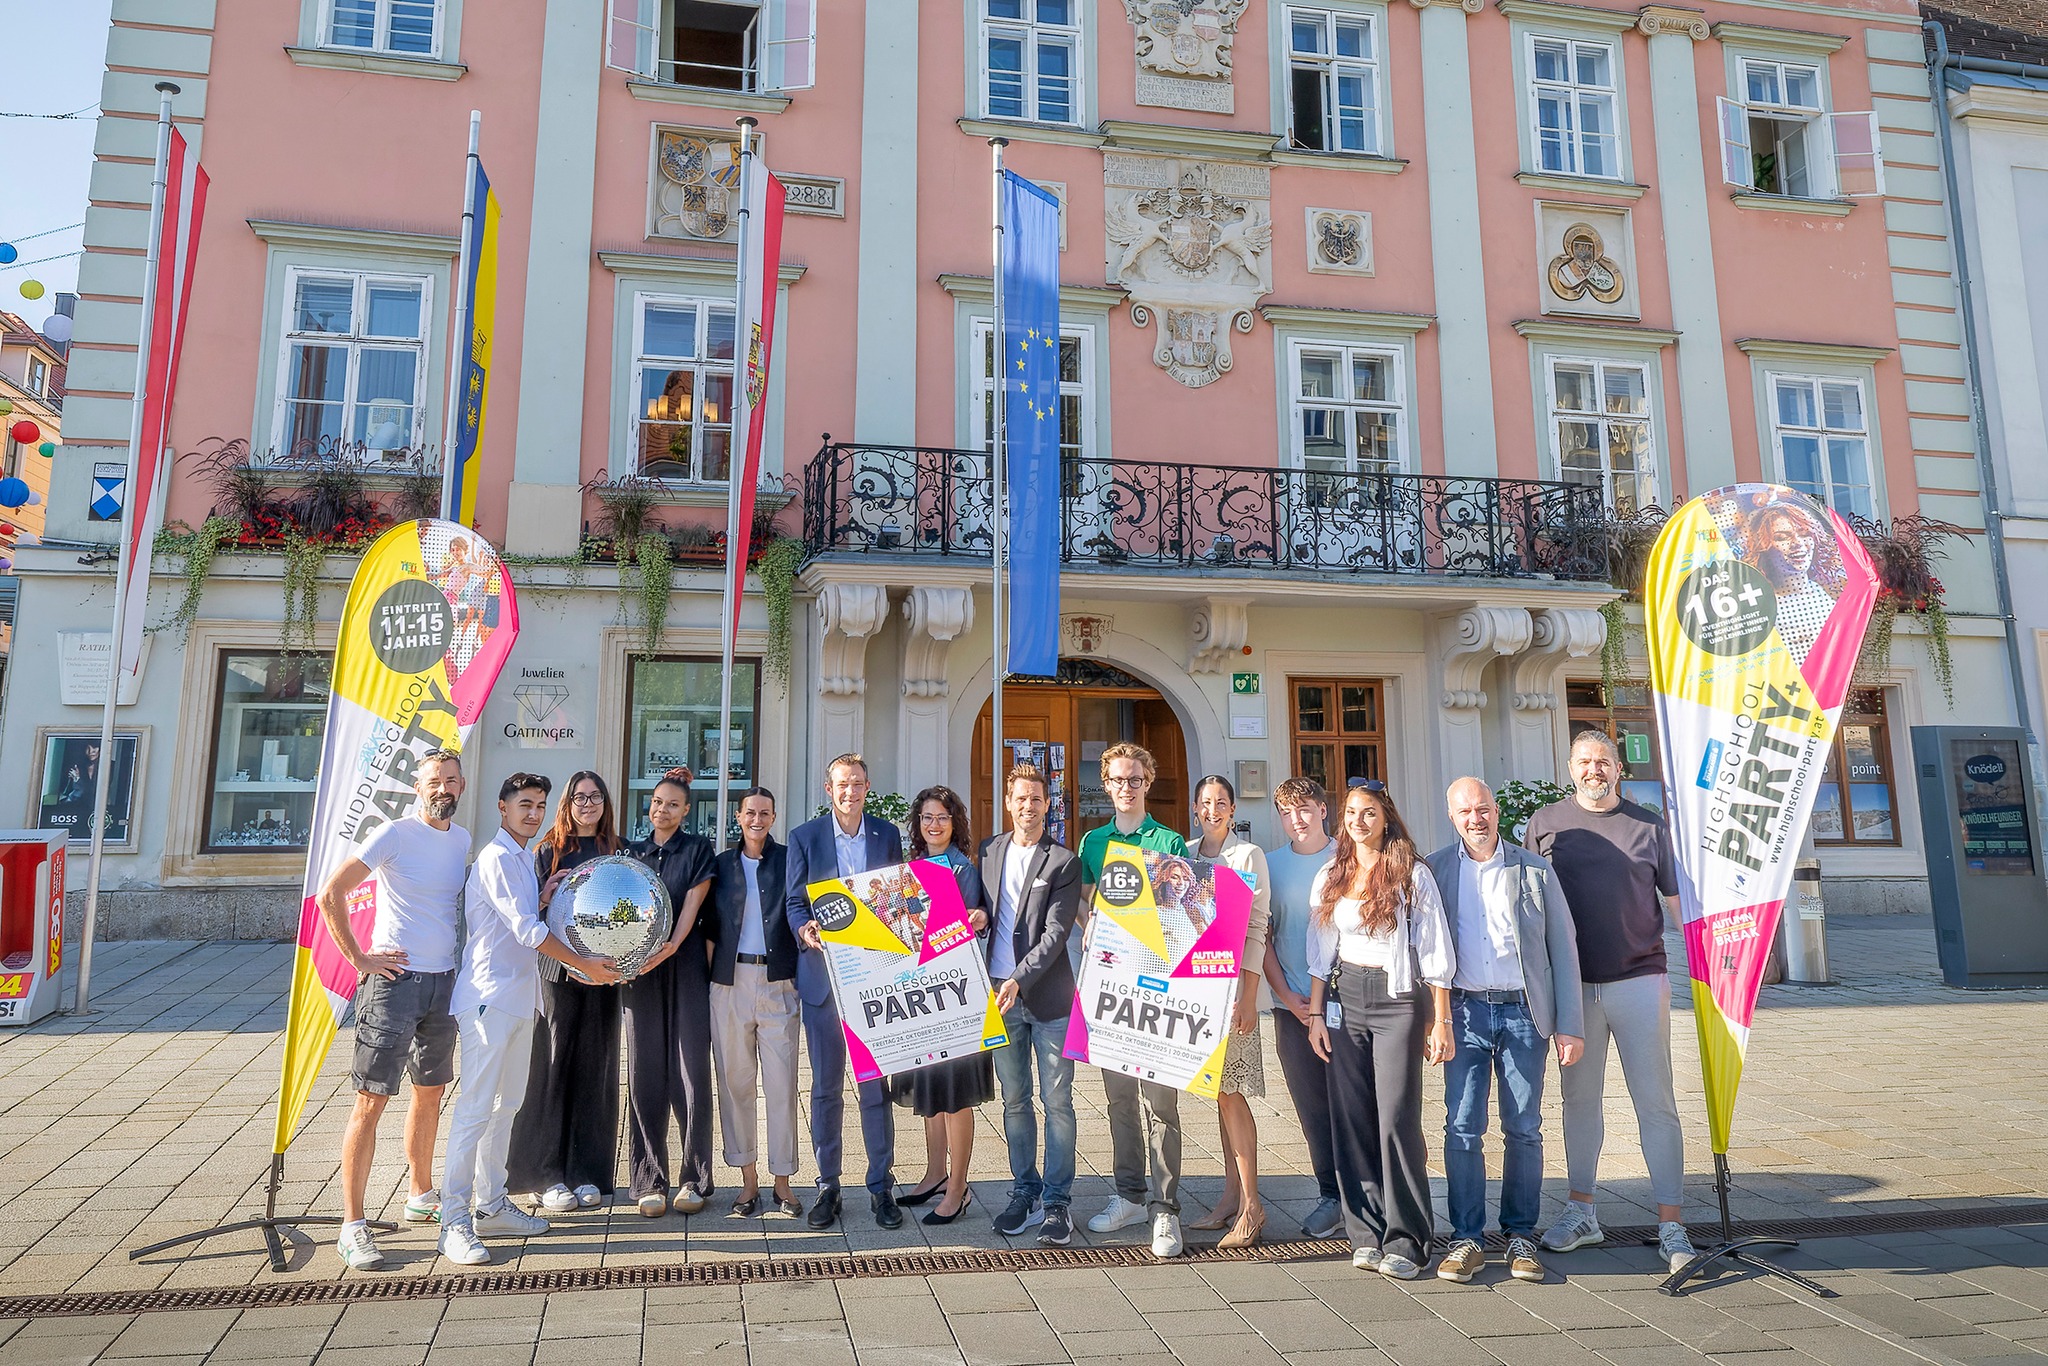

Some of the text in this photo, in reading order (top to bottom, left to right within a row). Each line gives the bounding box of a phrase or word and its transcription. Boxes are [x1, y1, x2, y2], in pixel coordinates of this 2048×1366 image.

[1701, 571, 1730, 588] DAS
[382, 602, 441, 616] EINTRITT
[1685, 582, 1764, 626] 16+
[380, 612, 445, 636] 11-15
[1724, 624, 1763, 642] LEHRLINGE
[382, 633, 442, 651] JAHRE
[339, 675, 430, 841] MIDDLESCHOOL
[1701, 680, 1765, 853] HIGHSCHOOL
[1718, 680, 1811, 872] PARTY+
[1851, 762, 1881, 777] point
[1967, 762, 2004, 775] Knödel!
[1770, 715, 1825, 864] www.highschool-party.at
[50, 814, 78, 823] BOSS
[1962, 810, 2023, 825] KNÖDELHEURIGER
[1101, 872, 1140, 889] 16+
[815, 897, 846, 913] EINTRITT
[817, 901, 850, 921] 11-15
[821, 908, 852, 926] JAHRE
[1712, 912, 1753, 930] AUTUMN
[928, 919, 963, 943] AUTUMN
[932, 929, 971, 953] BREAK
[1715, 927, 1760, 947] BREAK
[1191, 950, 1234, 960] AUTUMN
[1192, 964, 1236, 974] BREAK
[858, 967, 968, 1001] MIDDLESCHOOL
[862, 977, 969, 1029] PARTY
[1100, 979, 1211, 1017] HIGHSCHOOL
[1094, 991, 1213, 1046] PARTY+
[872, 1038, 896, 1048] FREITAG
[905, 1029, 932, 1040] OKTOBER
[932, 1025, 948, 1034] 2025
[1124, 1037, 1152, 1049] OKTOBER
[1152, 1044, 1168, 1053] 2025
[1190, 1054, 1203, 1063] UHR
